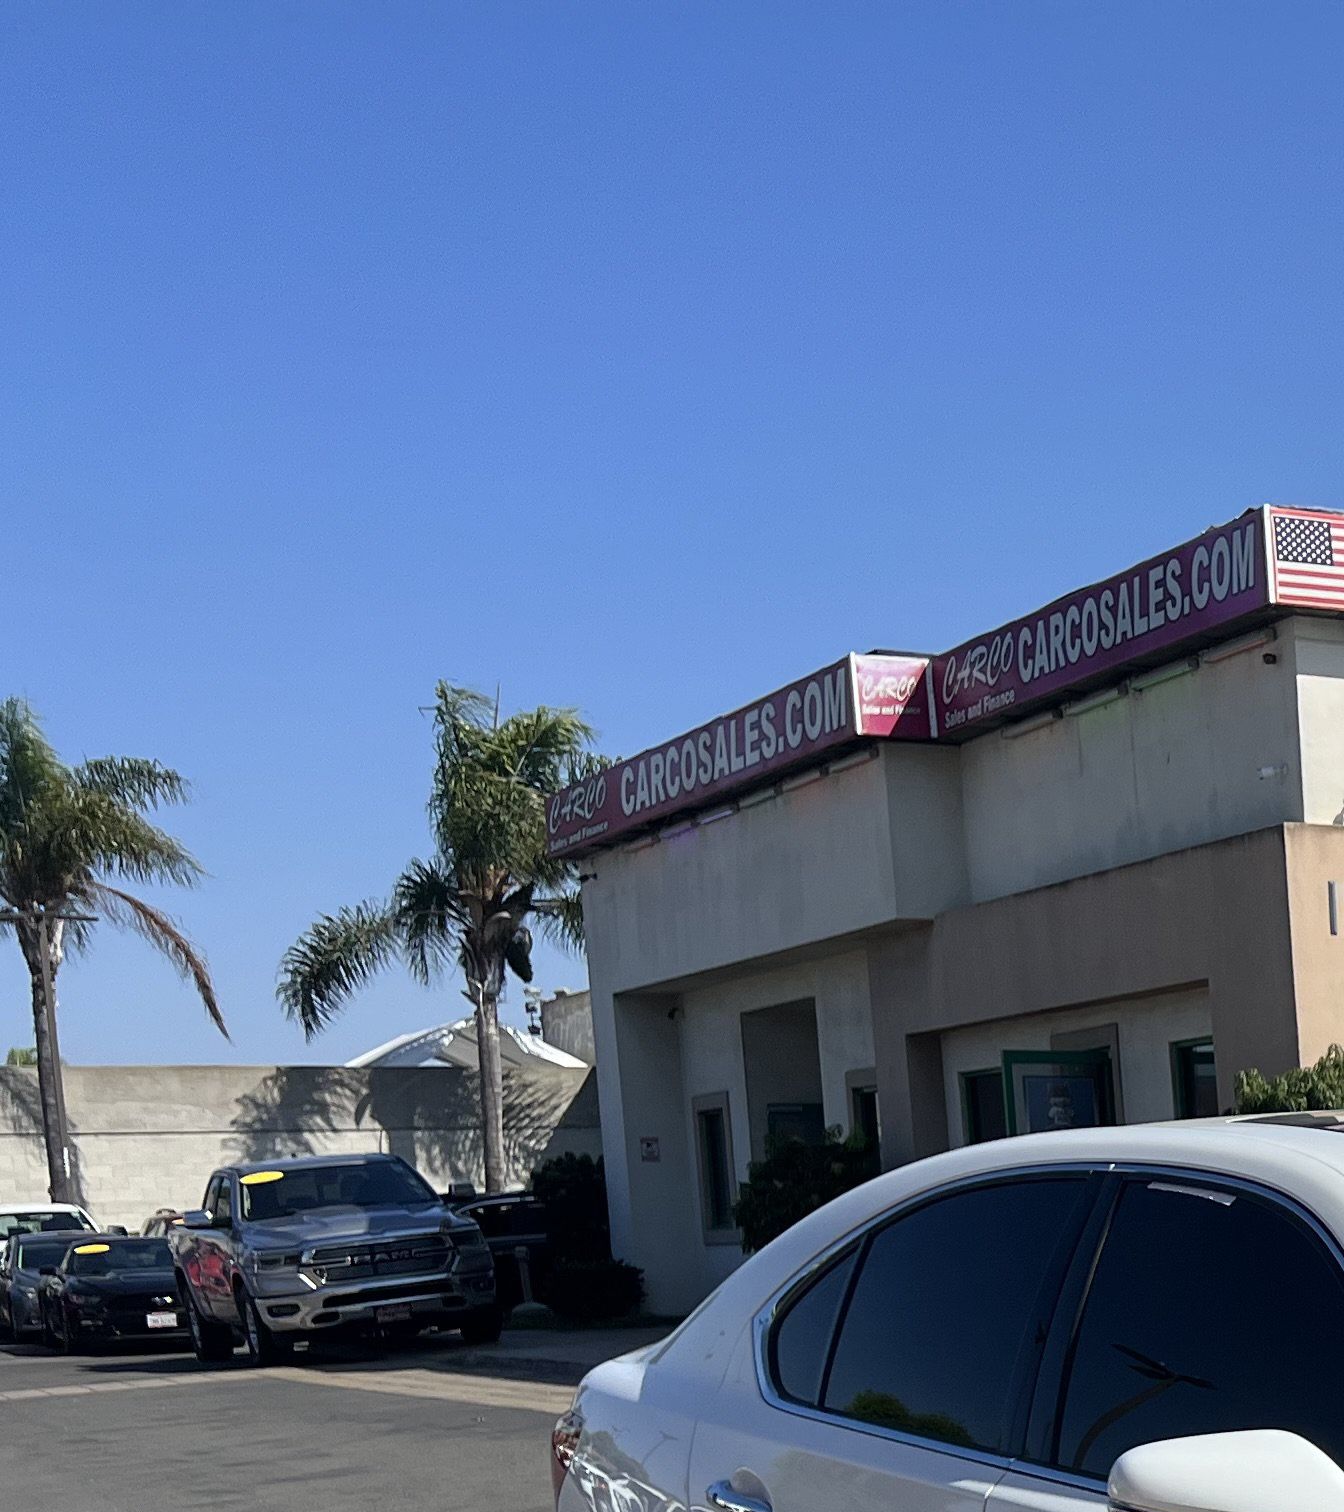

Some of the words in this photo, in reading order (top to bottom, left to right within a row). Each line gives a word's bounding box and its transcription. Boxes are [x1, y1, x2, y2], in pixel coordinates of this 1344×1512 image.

[1017, 521, 1256, 684] CARCOSALES.COM
[942, 631, 1014, 705] CARCO
[967, 699, 982, 720] and
[983, 689, 1016, 714] Finance
[620, 667, 847, 817] CARCOSALES.COM
[549, 775, 607, 834] CARCO
